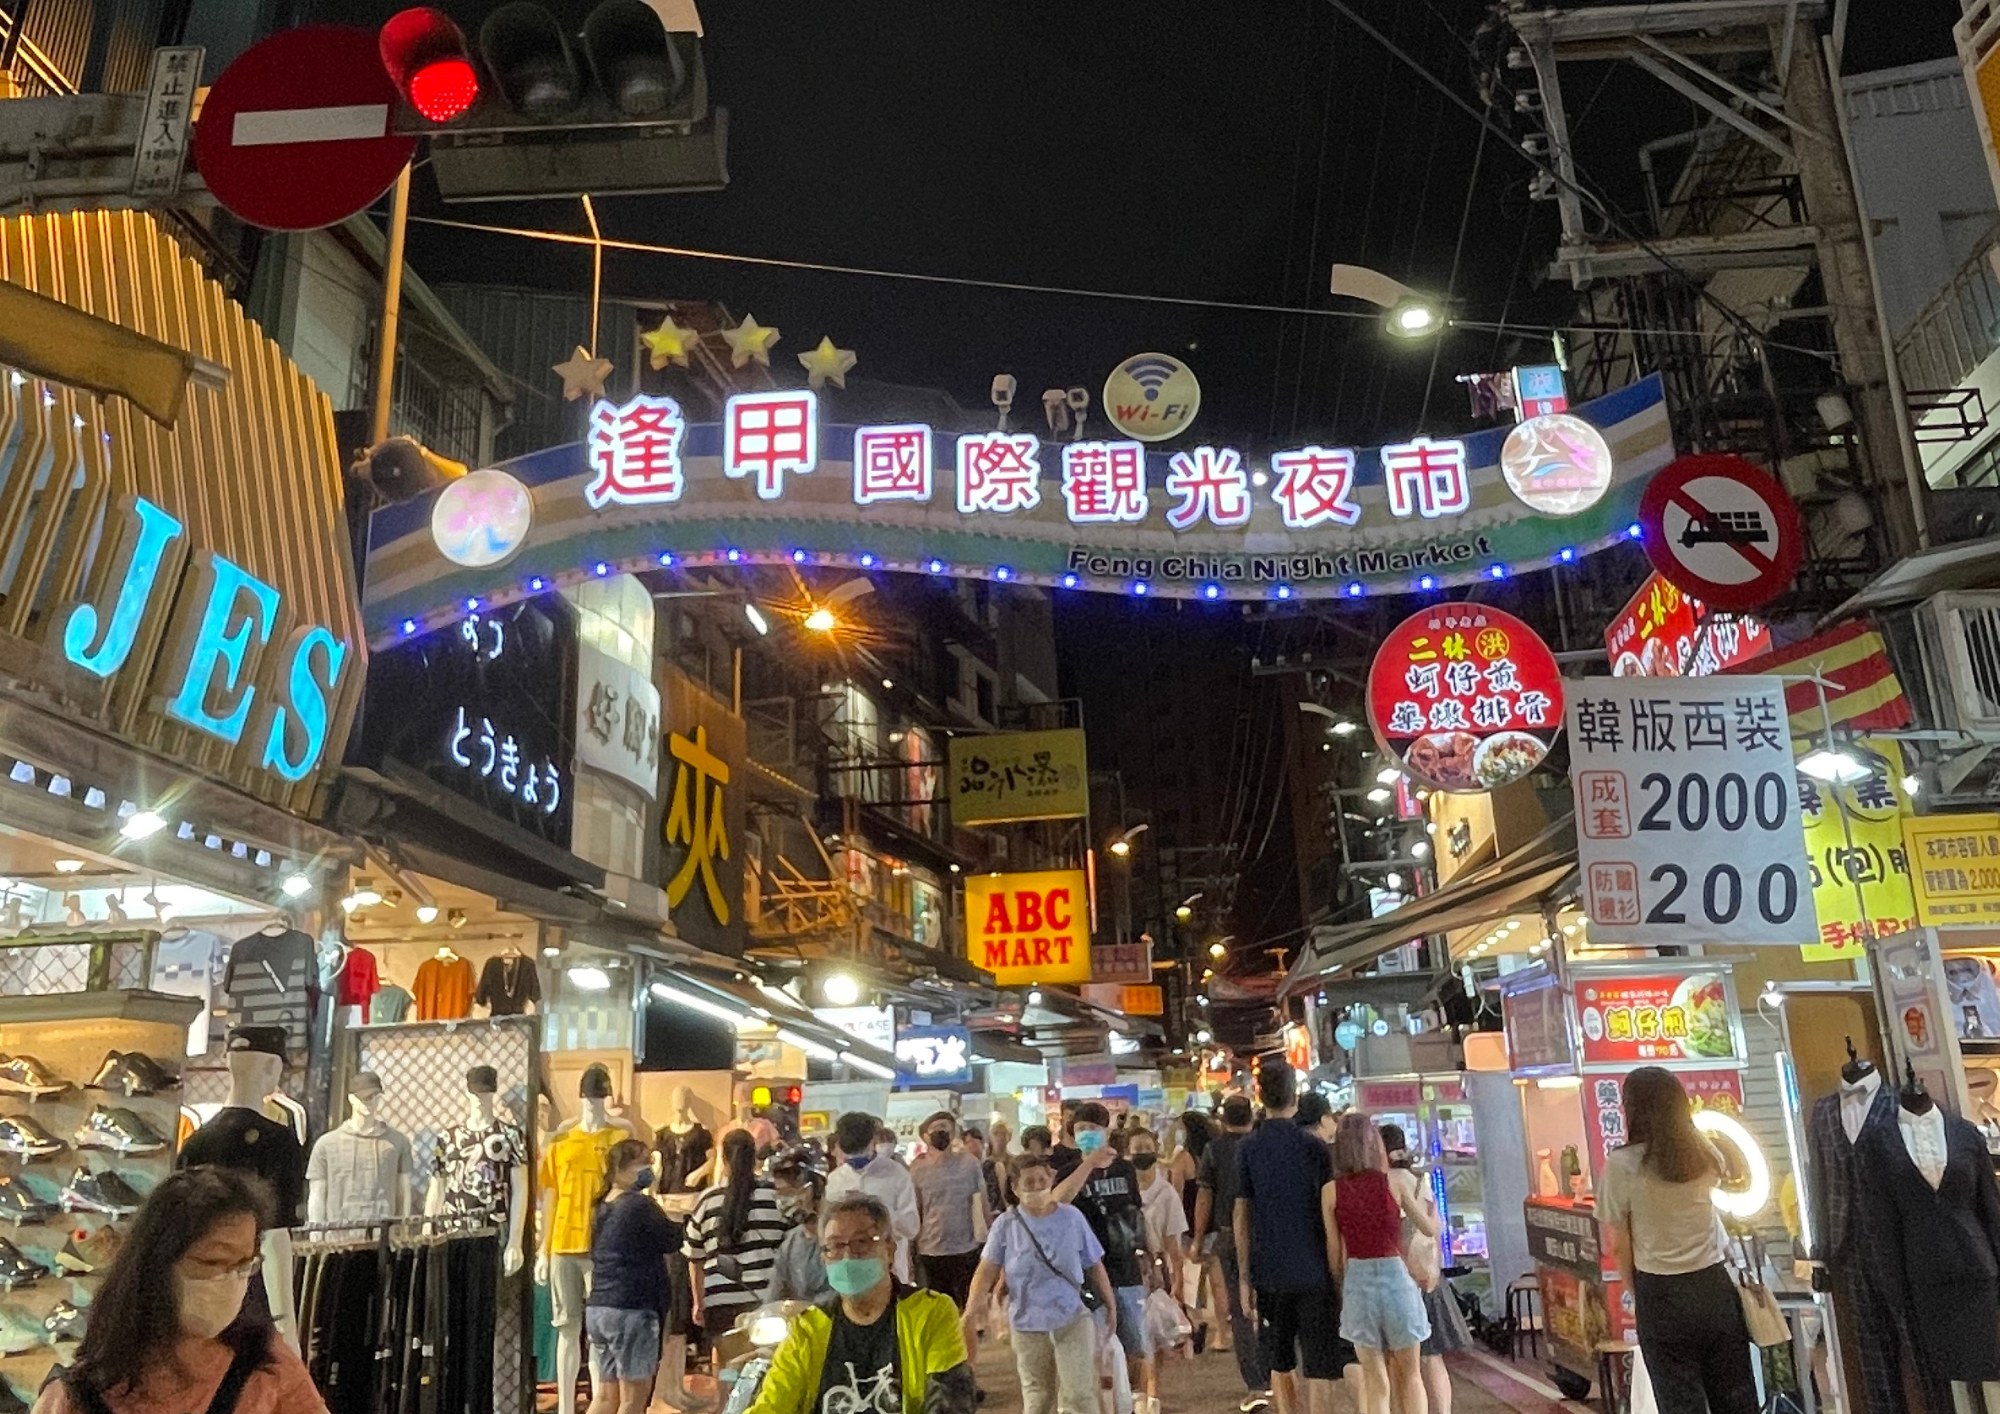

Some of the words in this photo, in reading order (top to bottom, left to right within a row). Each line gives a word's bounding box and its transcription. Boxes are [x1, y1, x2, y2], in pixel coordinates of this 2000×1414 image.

[153, 54, 188, 143] 禁止進入
[1116, 404, 1189, 421] Wi-Fi
[588, 393, 1469, 529] 逢甲國際觀光夜市
[1069, 550, 1153, 577] Feng
[1162, 557, 1243, 577] Chia
[1254, 556, 1349, 579] Night
[1359, 536, 1492, 573] Market
[64, 495, 346, 782] JES
[1405, 660, 1521, 696] 蚵仔煎
[1390, 693, 1550, 731] 藥燉排骨
[1576, 697, 1783, 752] 韓版西裝
[452, 706, 560, 813] とうきょう
[1591, 776, 1623, 835] 成套
[1638, 772, 1787, 831] 2000
[983, 888, 1071, 934] ABC
[1645, 863, 1798, 925] 200
[983, 936, 1073, 967] MART
